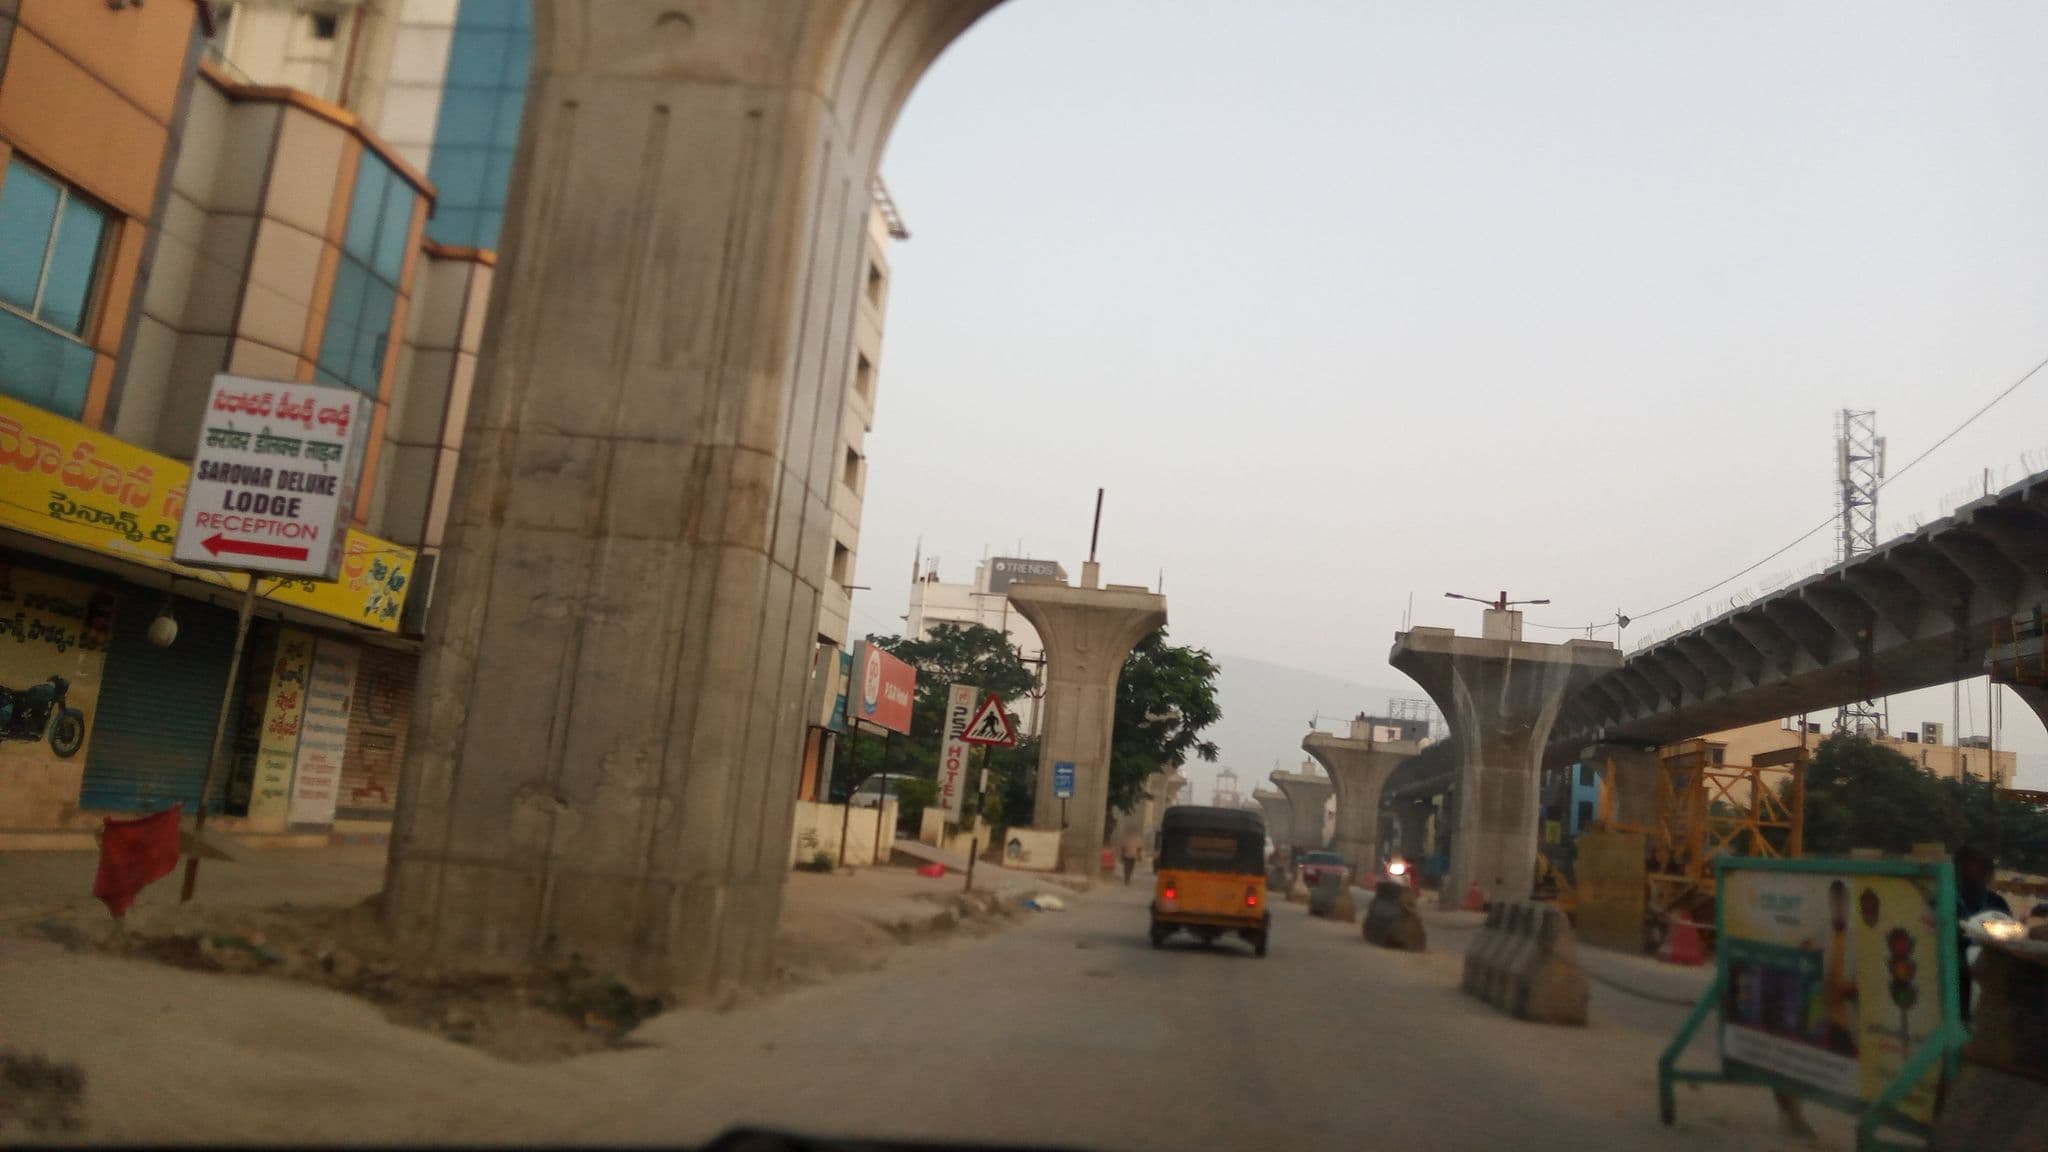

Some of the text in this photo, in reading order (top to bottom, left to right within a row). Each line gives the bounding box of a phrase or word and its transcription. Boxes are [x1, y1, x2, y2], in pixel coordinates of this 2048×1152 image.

[198, 460, 337, 496] SAROVAR DELUXE
[222, 490, 302, 518] LODGE
[195, 511, 319, 540] RECEPTION
[1007, 562, 1054, 575] TRENDS
[942, 745, 962, 809] HOTEL
